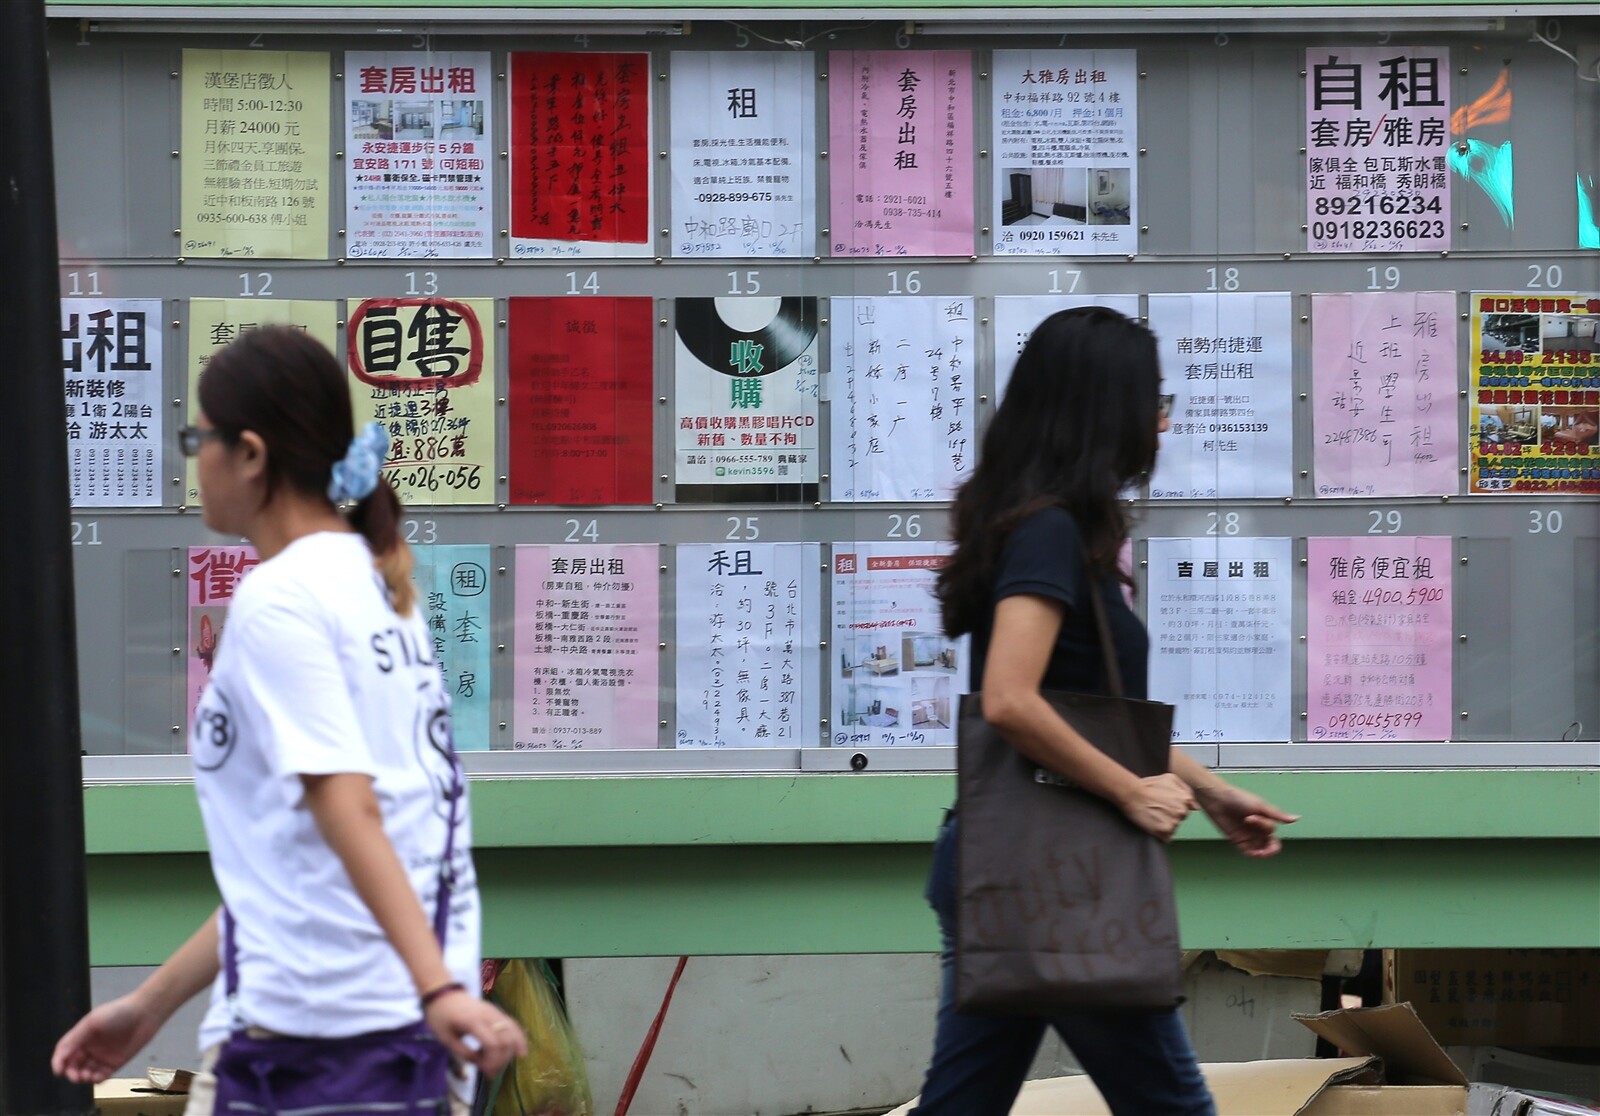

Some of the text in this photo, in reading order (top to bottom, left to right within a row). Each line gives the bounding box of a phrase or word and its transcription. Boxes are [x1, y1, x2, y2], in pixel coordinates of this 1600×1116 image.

[736, 25, 749, 48] 5
[896, 25, 910, 48] 6
[204, 71, 293, 90] 漢堡店徵人
[360, 66, 476, 94] 套房出租
[1021, 68, 1107, 85] 大雅房出租
[1314, 55, 1445, 111] 自租
[203, 98, 303, 112] 時間 5:00-12:30
[727, 88, 757, 119] 租
[1003, 92, 1120, 104] 中和福祥路 92 號 4 樓
[893, 68, 921, 170] 套房出租
[1001, 108, 1024, 118] 租金:
[1026, 108, 1049, 118] 6,800
[1097, 108, 1102, 117] 1
[1104, 108, 1123, 118] 個月
[204, 119, 300, 136] 月薪 24000 元
[362, 142, 474, 154] 永安捷運步行 5 分鐘
[353, 159, 389, 170] 宜安路
[394, 159, 416, 169] 171
[422, 159, 434, 170] 號
[1309, 156, 1446, 173] 傢俱全 包瓦斯水電
[1310, 173, 1446, 190] 近 福和橋 秀朗橋
[204, 194, 315, 208] 近中和板南路 126 號
[1315, 196, 1442, 215] 89216234
[197, 213, 307, 226] 0935-600-638 傅小姐
[883, 208, 941, 218] 0938-735-414
[1020, 230, 1044, 241] 0920
[1048, 230, 1085, 241] 159621
[1313, 220, 1445, 240] 0918236623
[69, 272, 102, 295] 11
[239, 272, 273, 296] 12
[405, 271, 438, 295] 13
[566, 271, 600, 295] 14
[727, 271, 761, 294] 15
[887, 270, 922, 294] 16
[1048, 270, 1082, 293] 17
[1206, 267, 1240, 291] 18
[1367, 266, 1400, 290] 19
[1526, 264, 1562, 288] 20
[363, 303, 471, 378] 自售
[1176, 336, 1263, 354] 南勢角捷運
[729, 340, 764, 409] 收購
[1185, 362, 1254, 380] 套房出租
[65, 379, 125, 398] 新裝修
[89, 422, 148, 440] 游太太
[680, 416, 815, 430] 高價收購黑膠唱片CD
[1209, 423, 1268, 433] 0936153139
[1203, 440, 1238, 452] 柯先生
[728, 466, 774, 475] kevin3596
[405, 520, 437, 544] 23
[564, 519, 599, 543] 24
[725, 517, 760, 540] 25
[887, 514, 921, 538] 26
[1206, 512, 1240, 535] 28
[1368, 510, 1402, 534] 29
[1528, 510, 1562, 534] 30
[71, 521, 102, 545] 21
[551, 557, 624, 575] 套房出租
[708, 550, 763, 576] 租
[838, 557, 855, 573] 租
[1178, 561, 1269, 578] 吉屋出租
[1330, 556, 1433, 580] 雅房便宜租
[456, 569, 480, 588] 租
[453, 610, 482, 697] 套房
[1329, 711, 1422, 728] 0980455899
